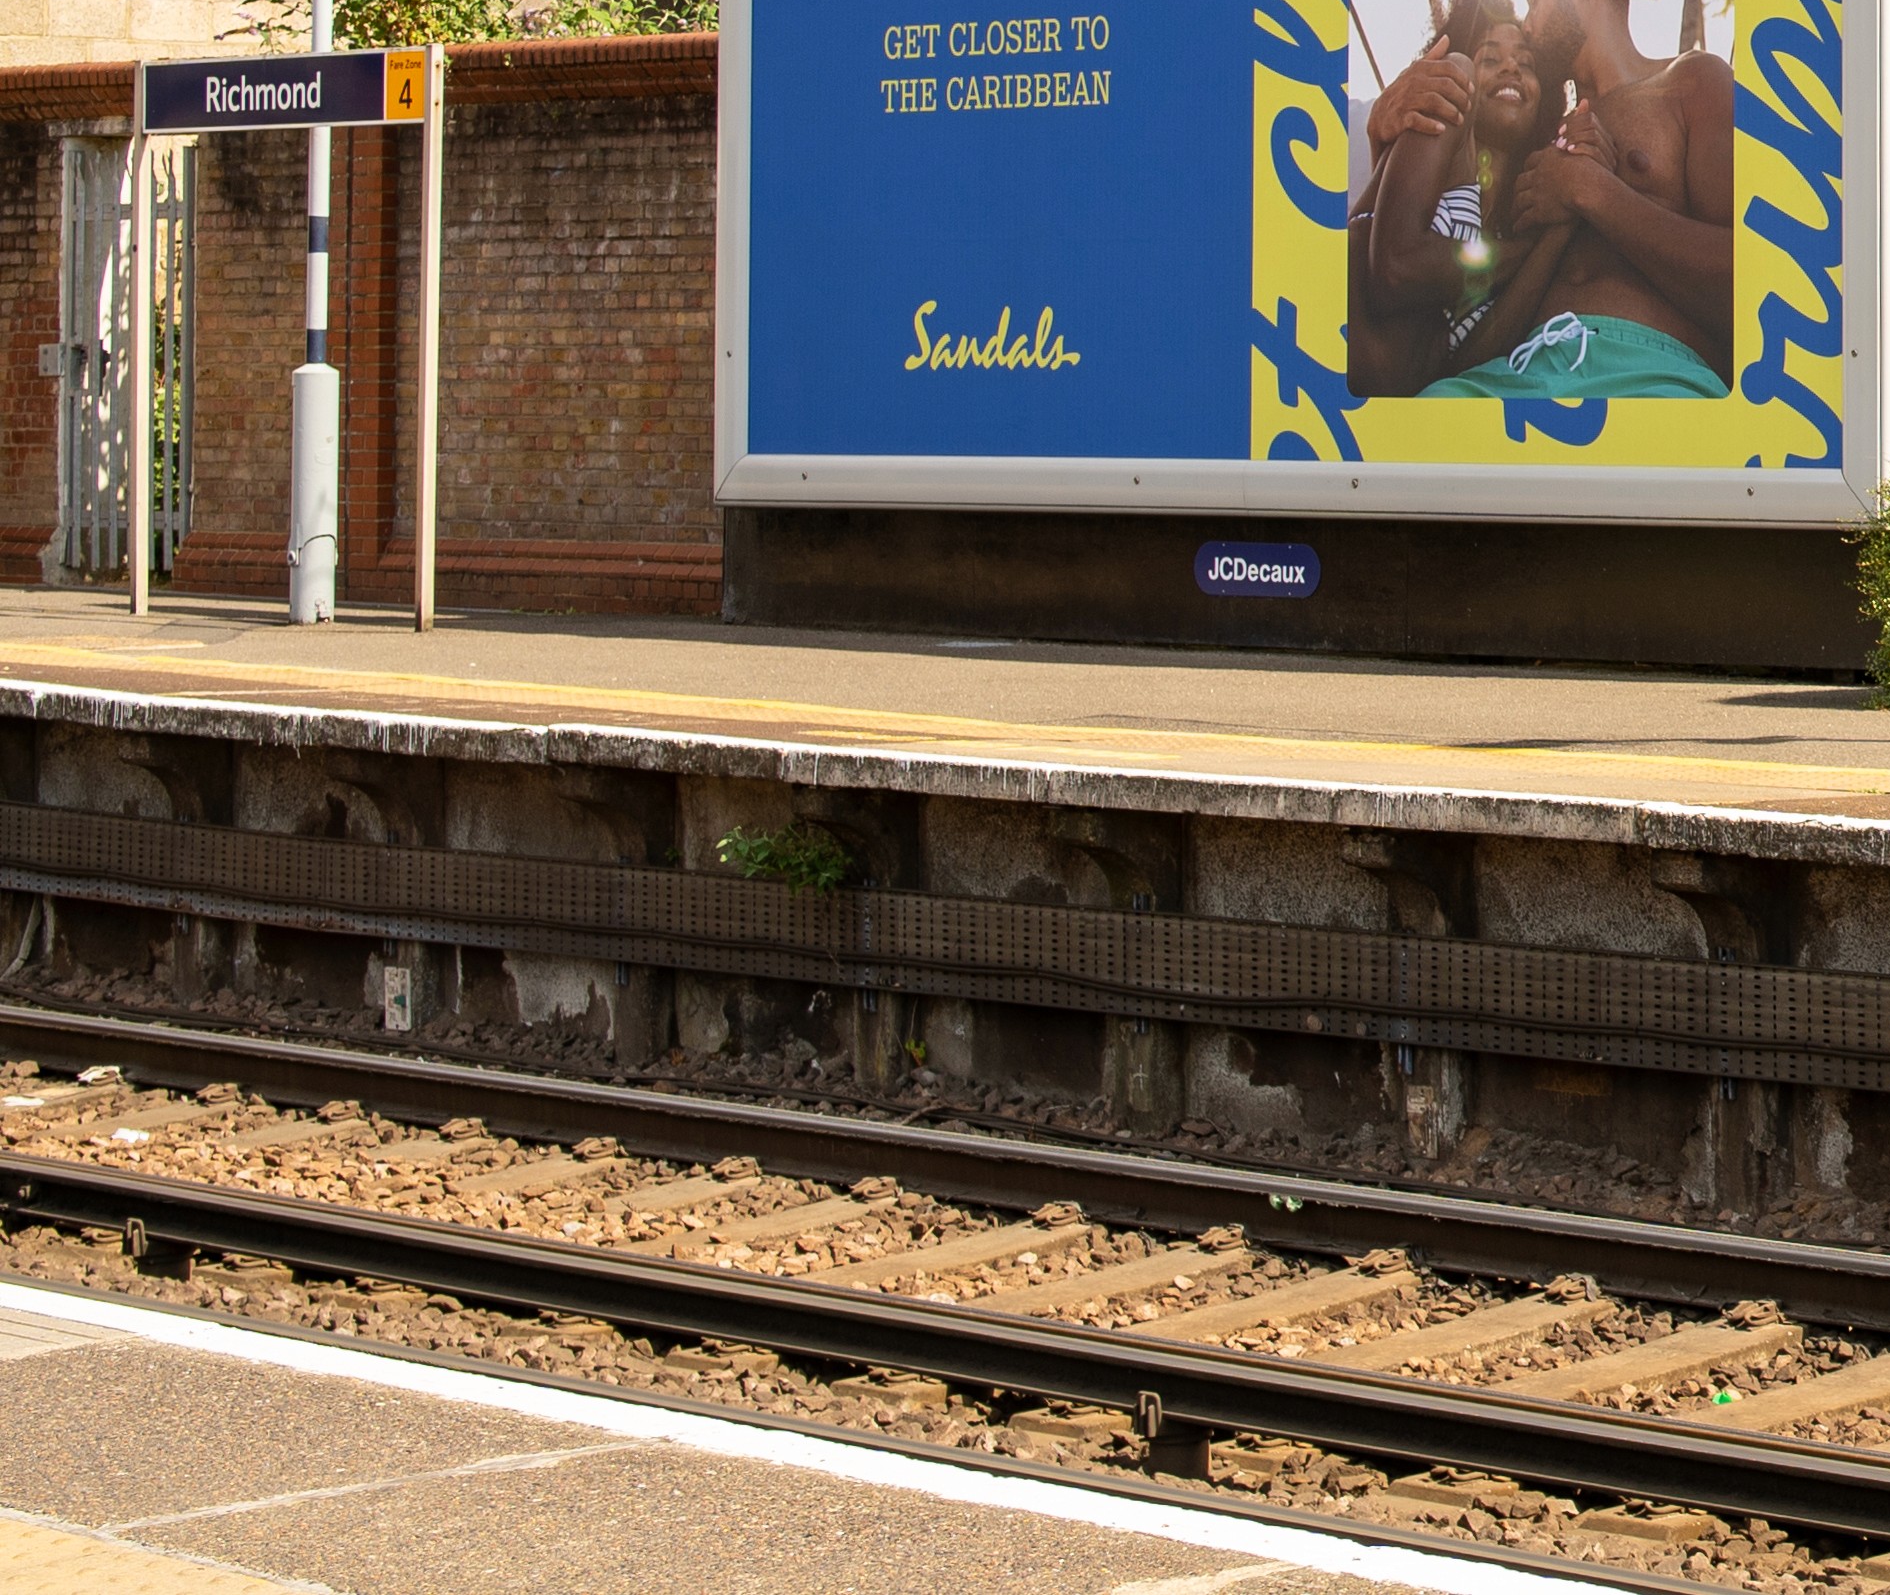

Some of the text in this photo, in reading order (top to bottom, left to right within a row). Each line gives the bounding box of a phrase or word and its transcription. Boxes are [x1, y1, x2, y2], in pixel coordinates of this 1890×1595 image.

[884, 15, 1110, 60] GET CLOSER TO
[389, 59, 422, 70] Fare Zone
[206, 71, 322, 113] Richmond
[398, 78, 413, 110] 4
[880, 70, 1111, 113] THE CARIBBEAN
[904, 300, 1081, 371] Sandals
[1208, 556, 1306, 585] JCDecaux
